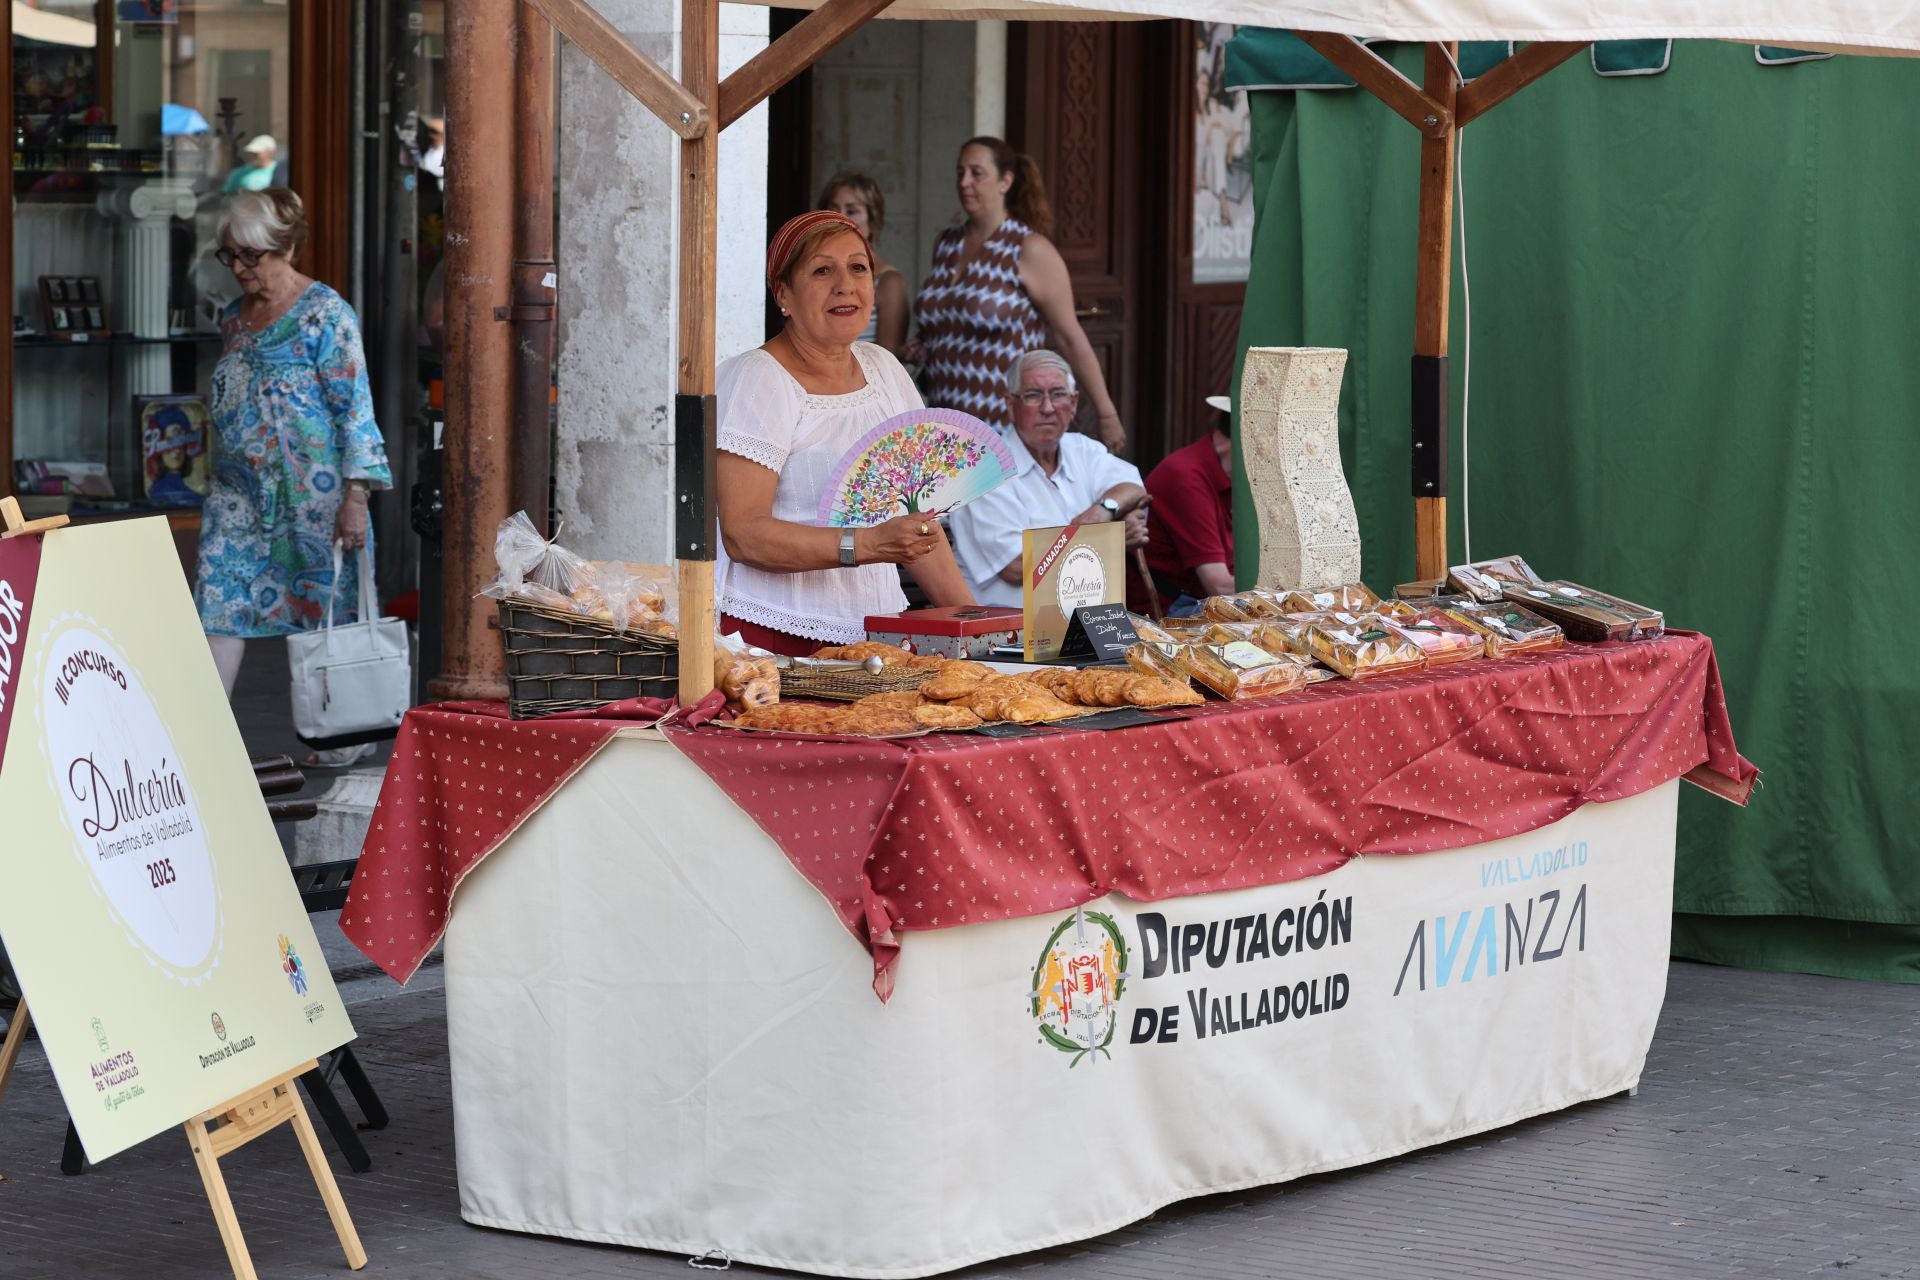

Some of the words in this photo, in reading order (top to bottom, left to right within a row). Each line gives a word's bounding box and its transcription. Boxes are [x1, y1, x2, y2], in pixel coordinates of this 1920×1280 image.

[1037, 534, 1068, 576] GANADOR
[1083, 611, 1107, 625] Corona
[55, 677, 69, 706] III
[62, 649, 127, 691] CONCURSO
[69, 752, 186, 837] Dulcería
[97, 833, 142, 861] Alimentos
[141, 825, 154, 847] de
[151, 811, 193, 841] Valladolid
[147, 858, 176, 889] 2025
[1481, 842, 1588, 888] VALLADOLID
[1136, 888, 1353, 980] DIPUTACIÓN
[1393, 883, 1587, 997] AVANZA
[1129, 1005, 1179, 1045] DE
[1187, 972, 1350, 1040] VALLADOLID
[91, 1050, 134, 1079] ALIMENTOS
[96, 1080, 105, 1092] DE
[103, 1066, 139, 1087] VALLADOLID
